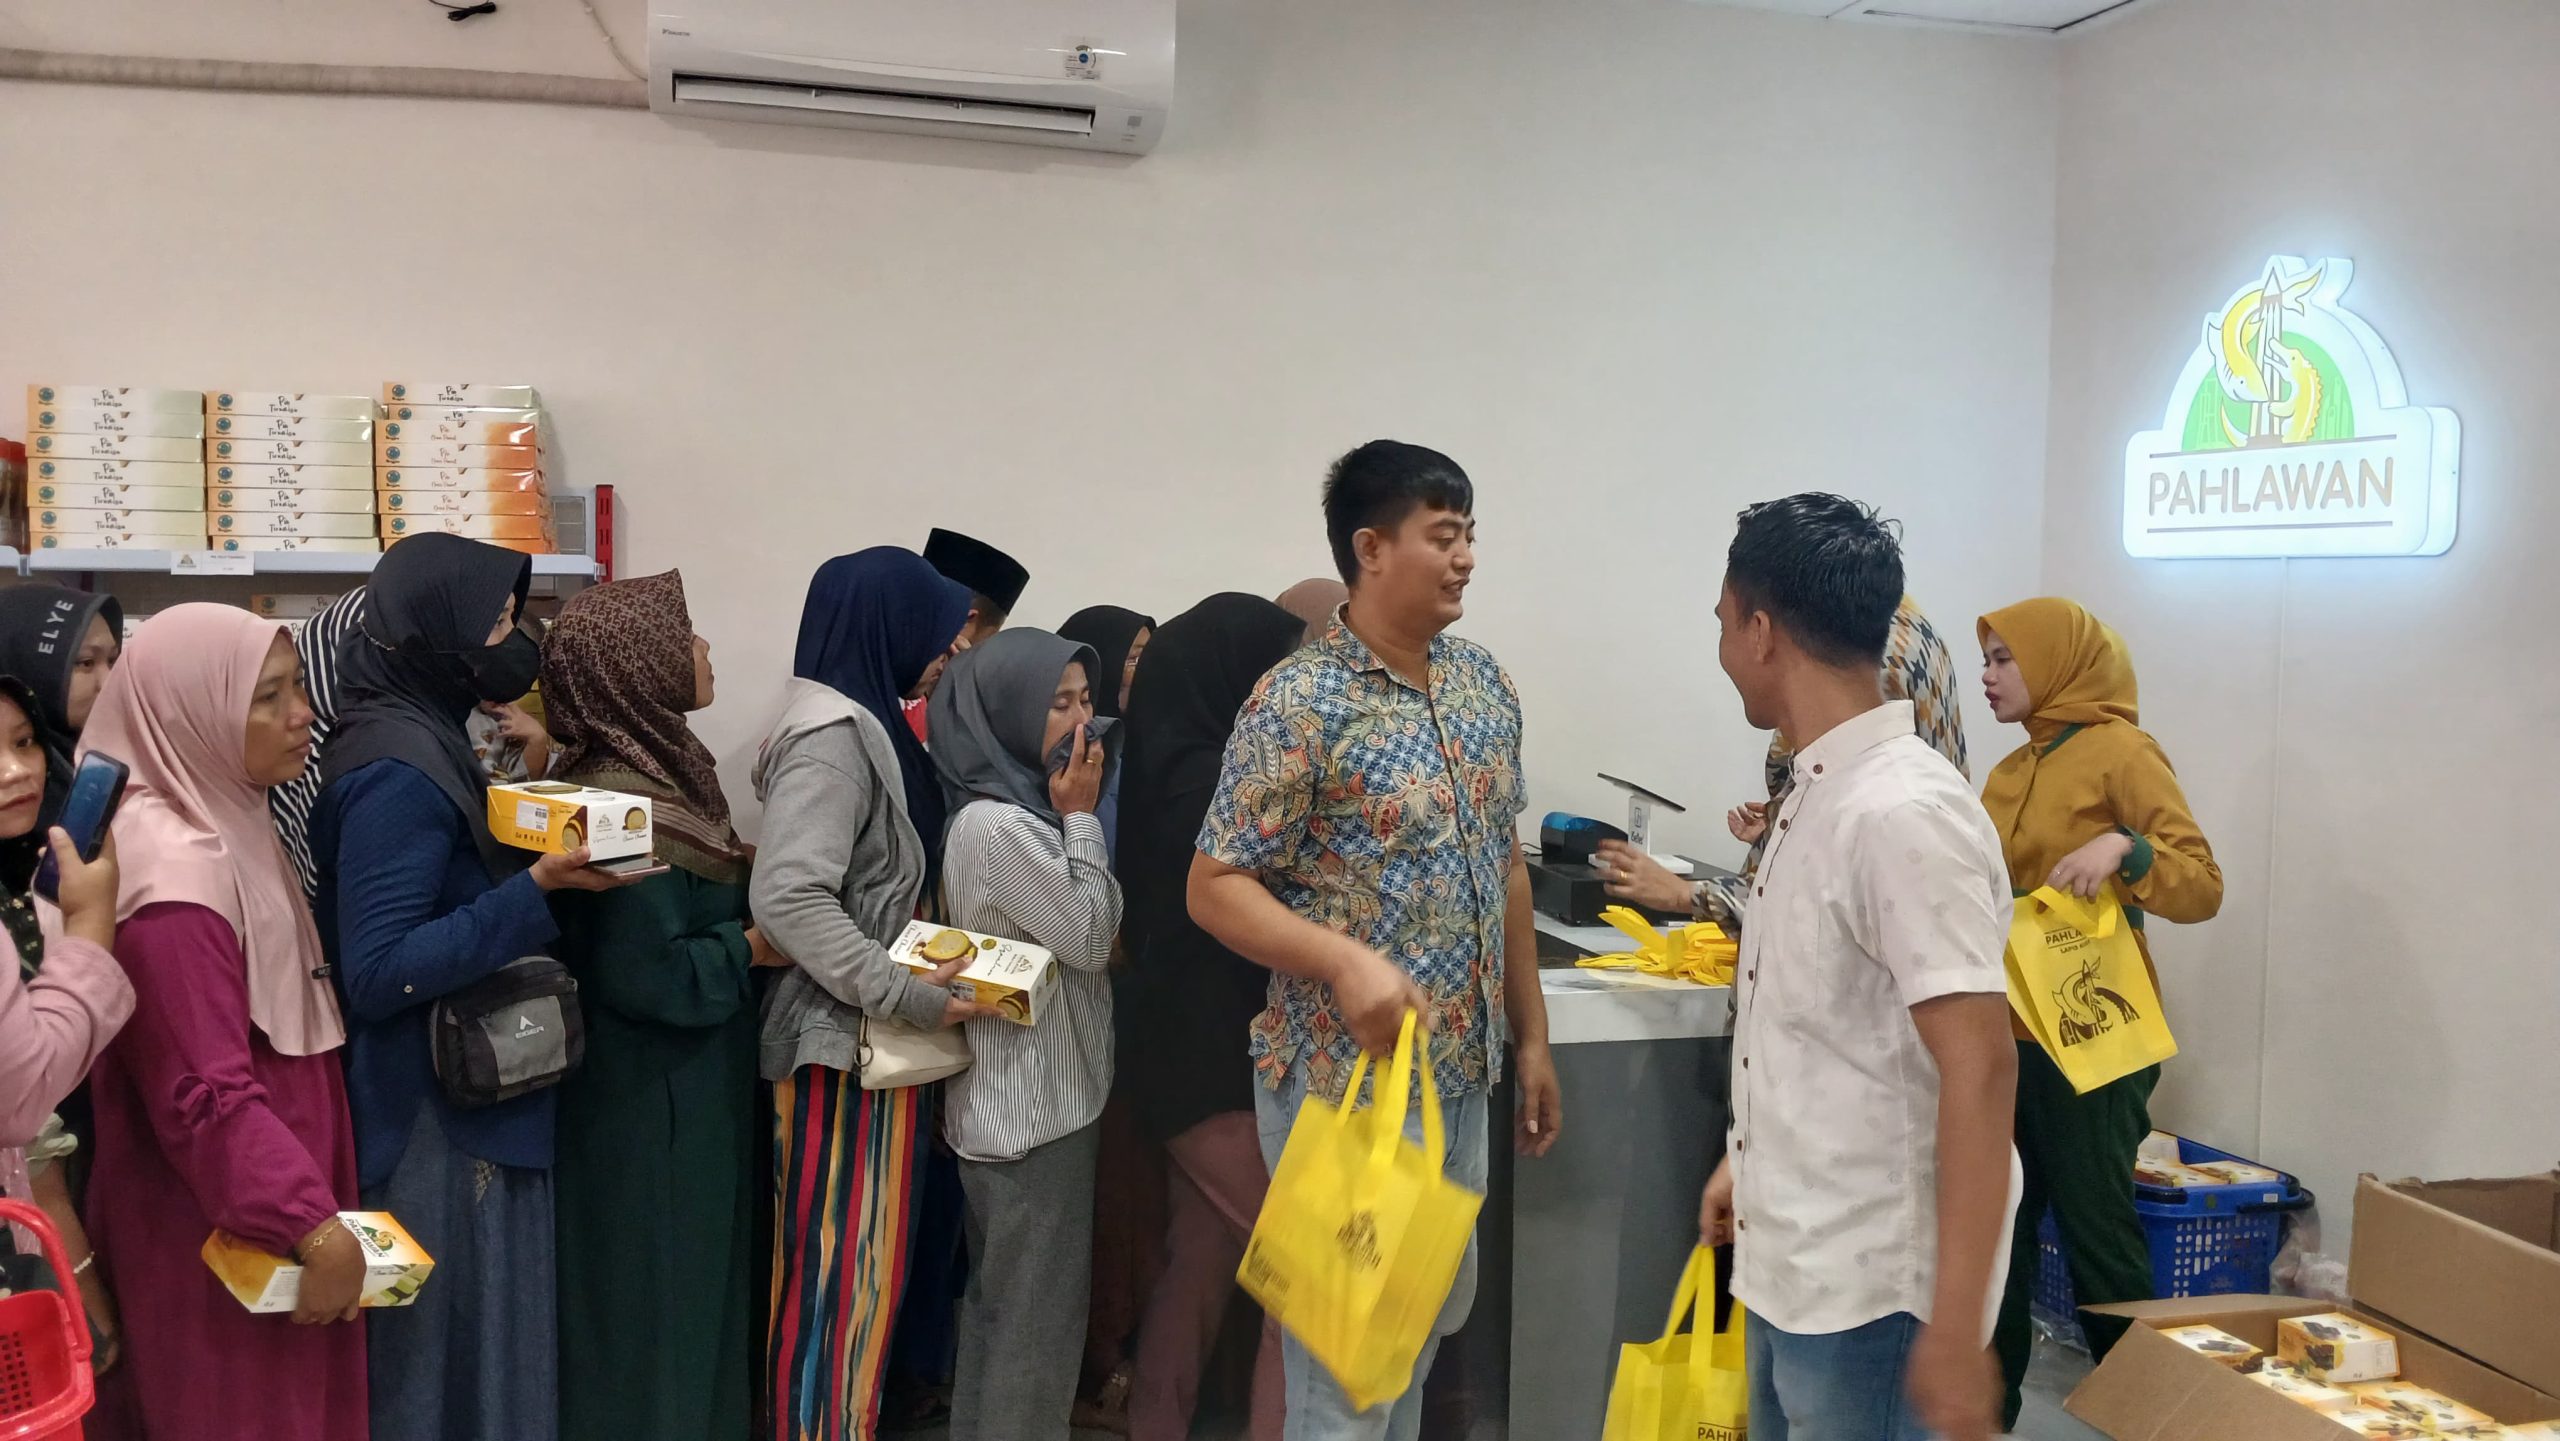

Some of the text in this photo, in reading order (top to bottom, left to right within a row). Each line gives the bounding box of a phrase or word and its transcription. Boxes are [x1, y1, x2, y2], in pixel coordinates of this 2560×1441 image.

[2149, 457, 2393, 516] PAHLAWAN
[38, 600, 74, 654] ELYE
[2046, 929, 2082, 945] PAHLA
